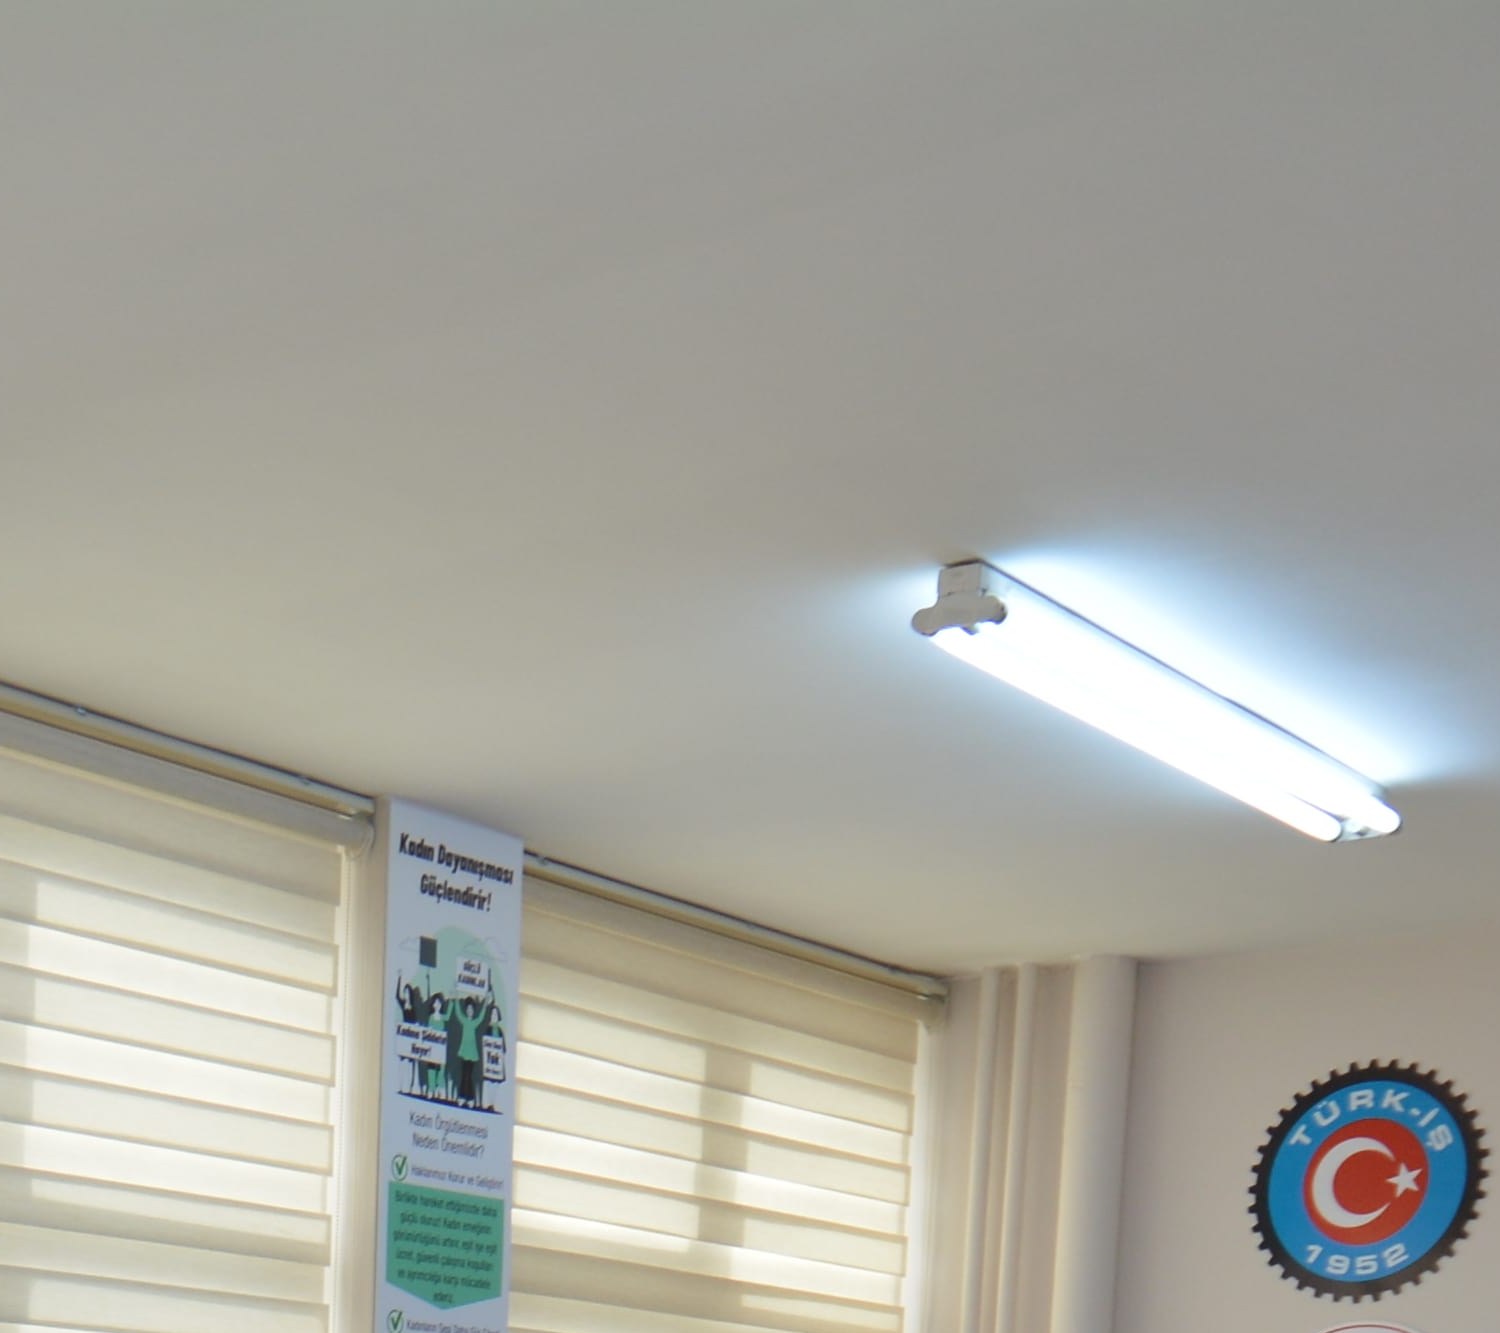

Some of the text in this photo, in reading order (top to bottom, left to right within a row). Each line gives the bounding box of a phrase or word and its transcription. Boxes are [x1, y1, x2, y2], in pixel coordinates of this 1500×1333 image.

[399, 832, 514, 885] Kadın Dayanışması
[420, 873, 492, 912] Güçlendirir!
[1289, 1087, 1455, 1153] TÜRK-İŞ
[1305, 1242, 1410, 1278] 1952
